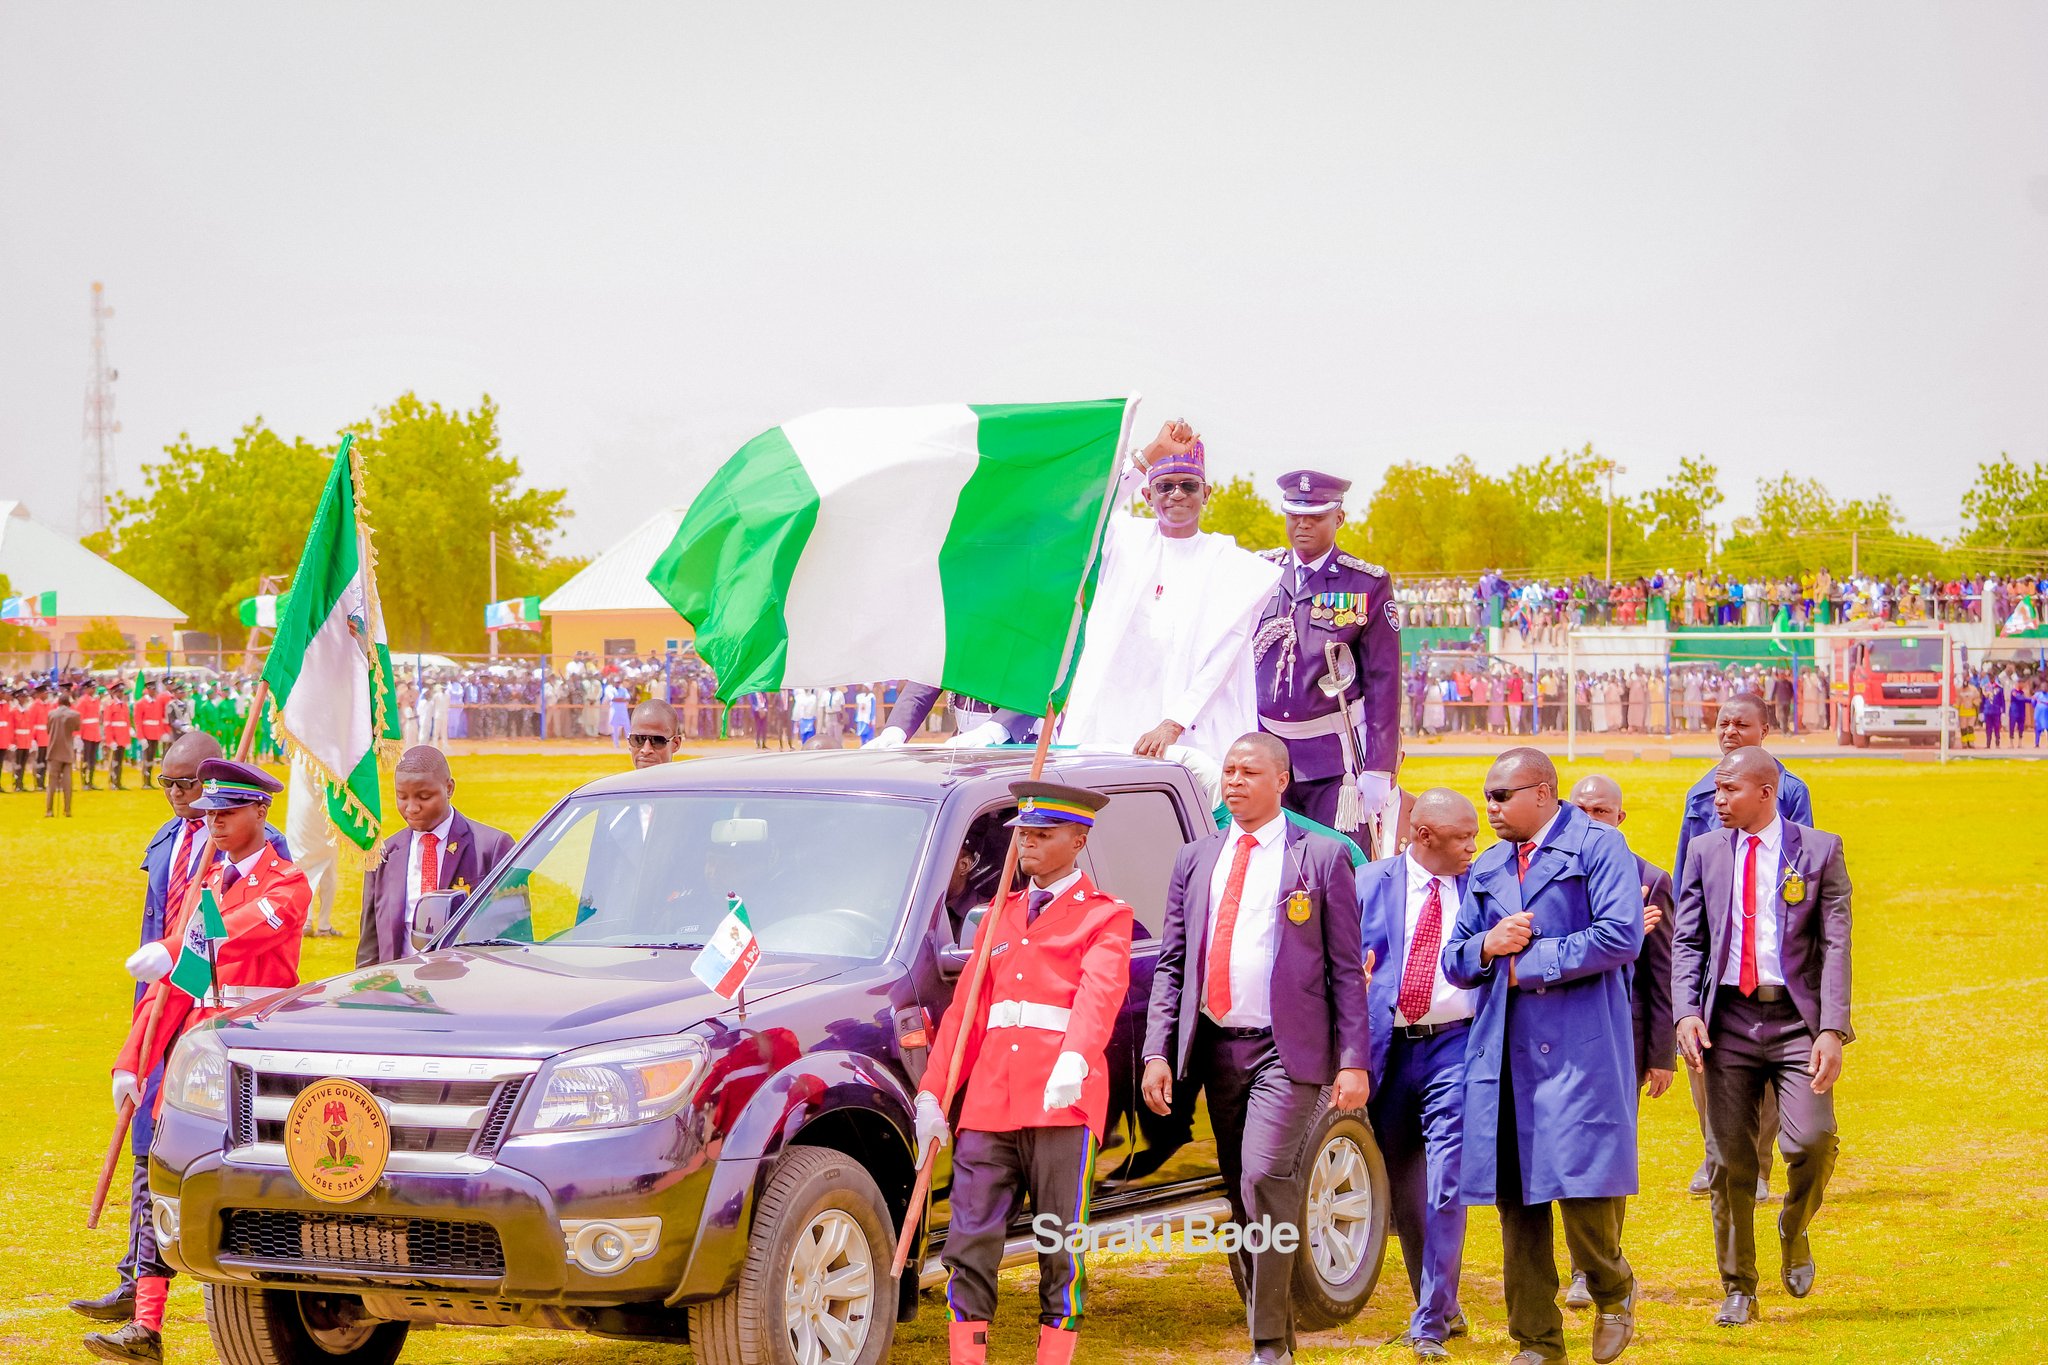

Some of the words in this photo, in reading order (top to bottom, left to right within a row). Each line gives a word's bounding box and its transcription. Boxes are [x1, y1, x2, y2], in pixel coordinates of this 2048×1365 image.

[743, 945, 759, 970] APC
[259, 1055, 488, 1075] RANGER
[294, 1088, 332, 1134] EXECUTIVE
[335, 1088, 380, 1128] GOVERNOR
[311, 1172, 333, 1190] YOBE
[337, 1174, 365, 1191] STATE
